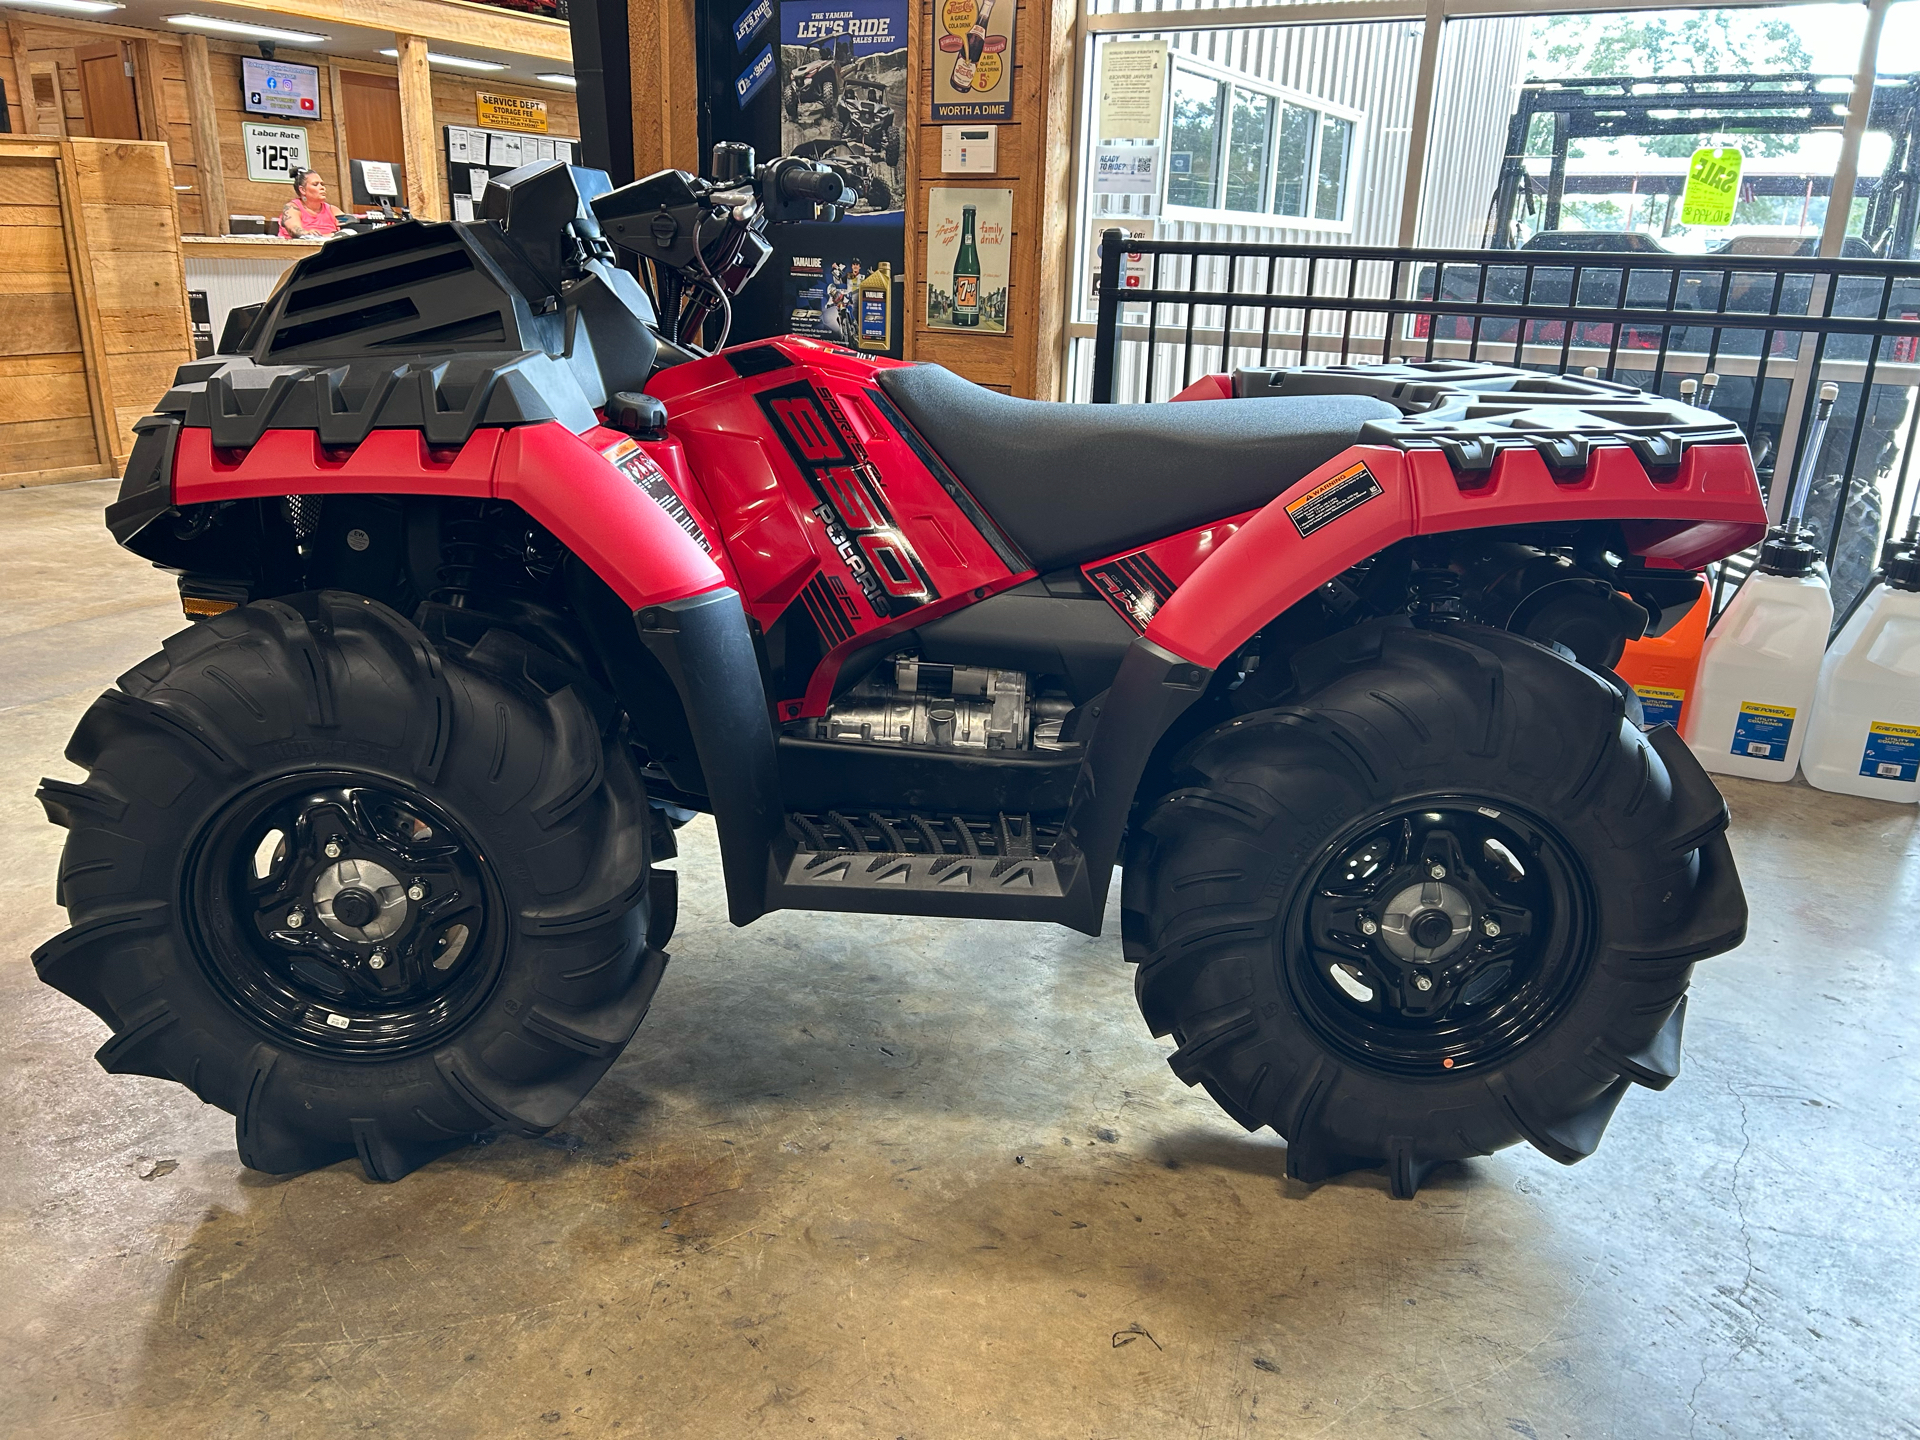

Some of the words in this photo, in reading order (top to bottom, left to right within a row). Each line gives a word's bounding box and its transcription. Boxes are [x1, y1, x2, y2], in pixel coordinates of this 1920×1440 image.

[736, 16, 754, 40] LET'S
[797, 20, 844, 38] LET'S
[848, 18, 890, 35] RIDE
[483, 96, 518, 108] SERVICE
[520, 101, 542, 110] DEPT.
[940, 106, 972, 115] WORTH
[974, 106, 980, 114] A
[982, 105, 1004, 114] DIME
[494, 106, 521, 116] STORAGE
[252, 129, 278, 138] Labor
[280, 131, 300, 139] Rate
[980, 221, 1004, 235] family
[980, 234, 1004, 246] drink!
[792, 257, 823, 268] YAMALUBE
[1312, 474, 1346, 496] WARNING
[769, 397, 928, 598] 850
[811, 502, 893, 620] POLARIS
[828, 576, 862, 620] EFI
[1748, 718, 1783, 726] CONTAINER
